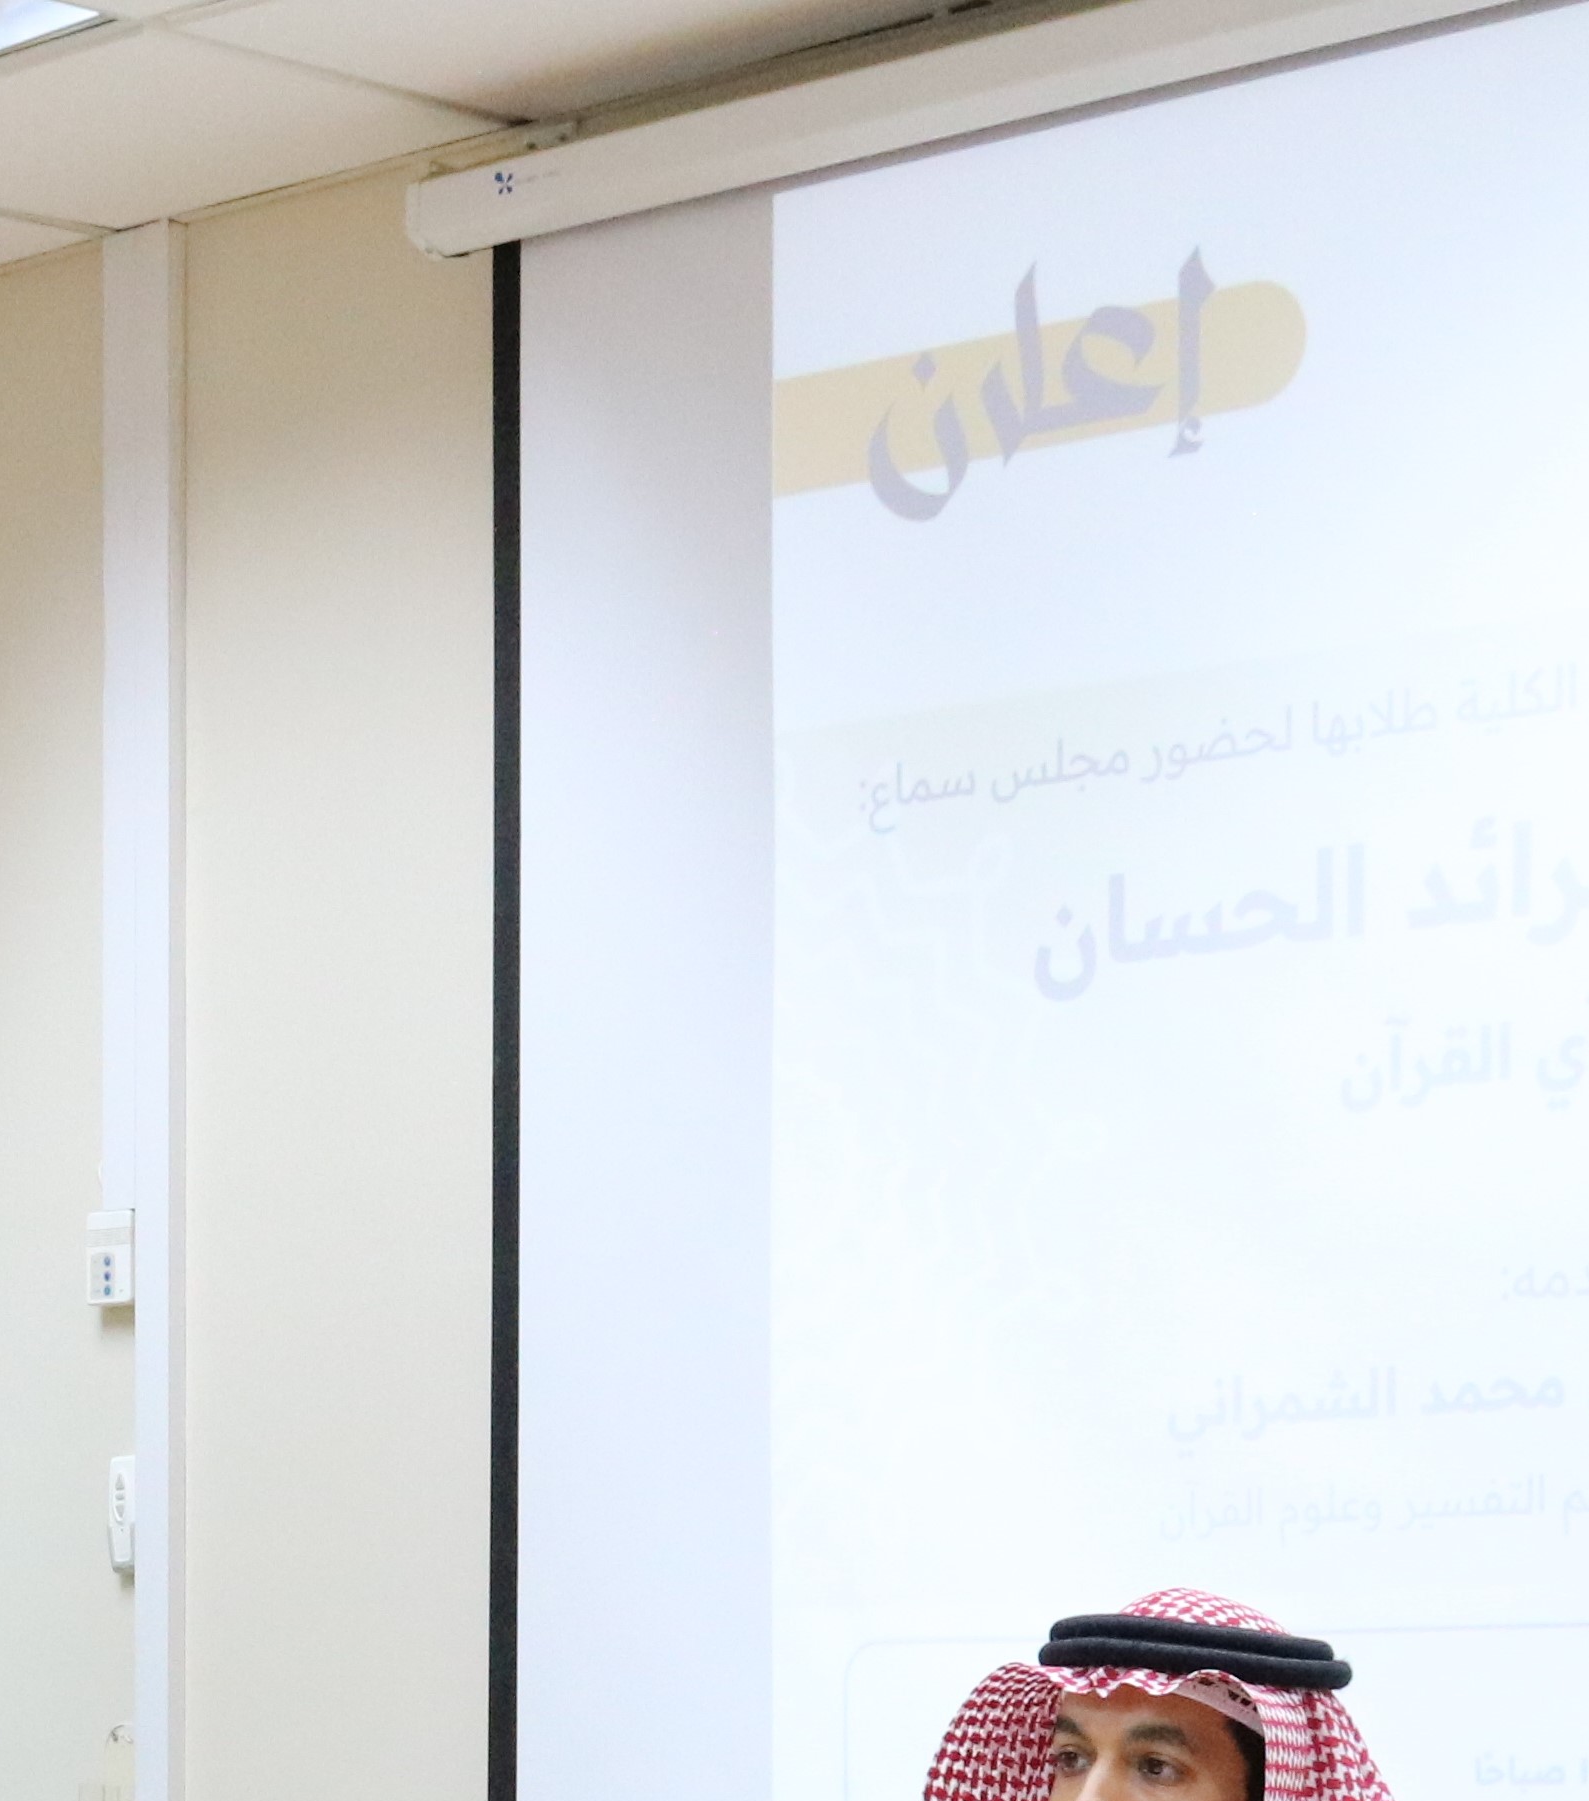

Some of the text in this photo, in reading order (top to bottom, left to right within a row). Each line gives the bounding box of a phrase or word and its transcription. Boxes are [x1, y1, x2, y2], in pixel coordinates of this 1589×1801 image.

[868, 243, 1215, 523] إعلان
[1310, 688, 1438, 754] طلابها
[1456, 661, 1578, 735] الكلية
[988, 738, 1131, 805] مجلس
[1140, 705, 1293, 784] لحضور
[858, 760, 976, 835] سماع:
[1033, 841, 1366, 1000] الحسان
[1339, 1014, 1512, 1112] القرآن
[1166, 1364, 1397, 1458] الشمراني
[1420, 1368, 1567, 1417] محمد
[1160, 1480, 1264, 1542] القرآن
[1278, 1482, 1382, 1546] وعلوم
[1401, 1473, 1547, 1532] التفسير
